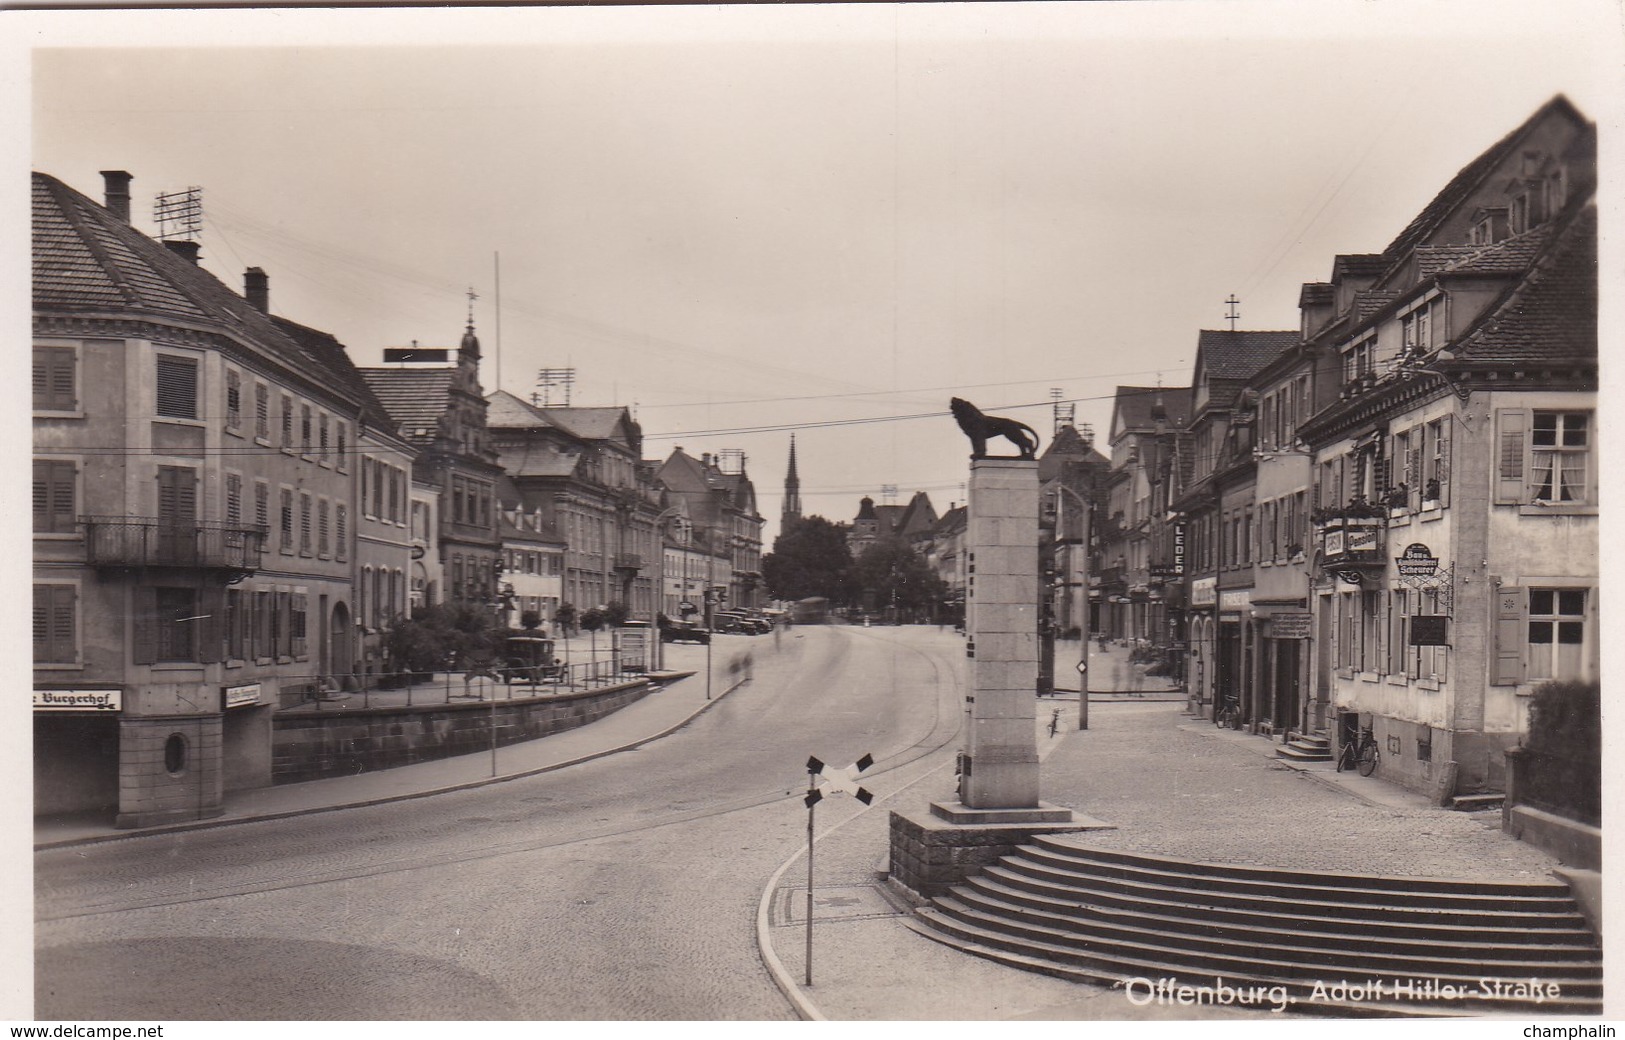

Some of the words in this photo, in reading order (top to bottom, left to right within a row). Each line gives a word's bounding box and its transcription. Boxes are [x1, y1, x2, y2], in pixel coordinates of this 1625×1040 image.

[1349, 533, 1376, 549] Pension
[1175, 526, 1184, 573] LEDER
[1400, 566, 1434, 574] Scheurer
[42, 692, 110, 705] Burgerhof
